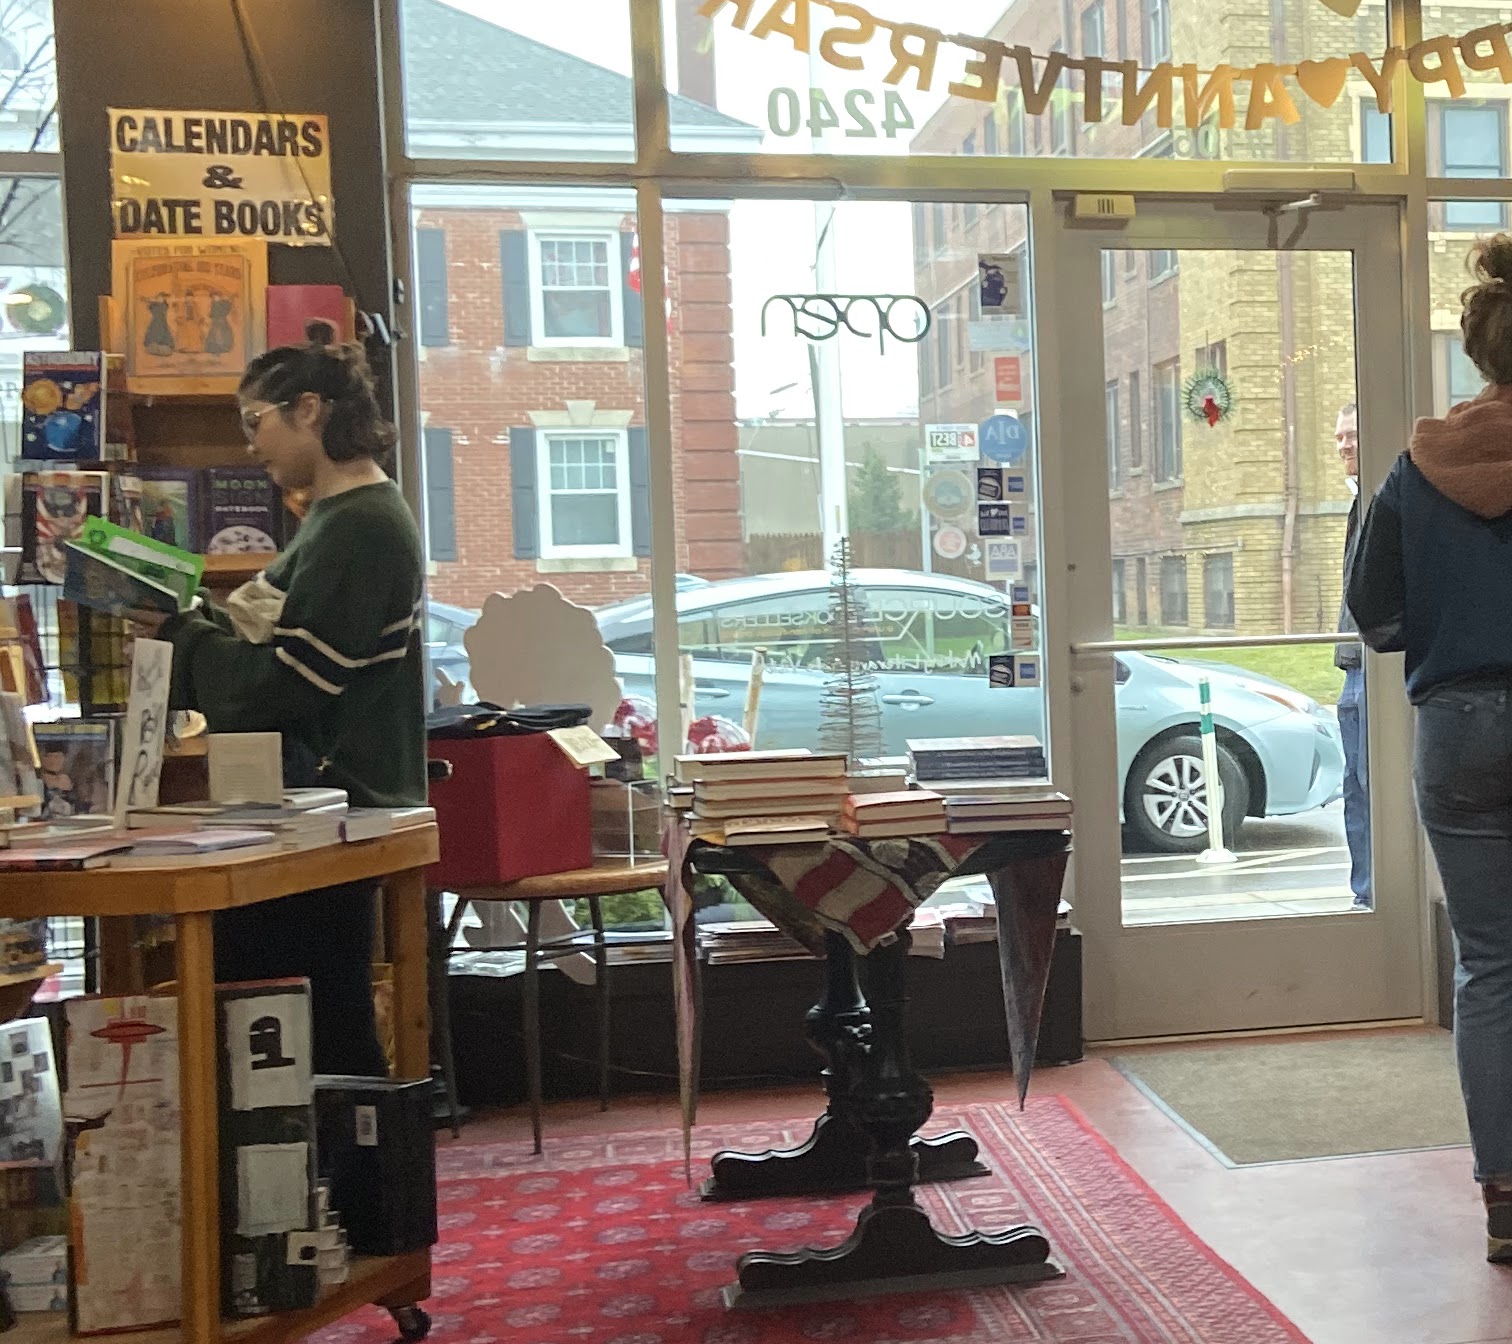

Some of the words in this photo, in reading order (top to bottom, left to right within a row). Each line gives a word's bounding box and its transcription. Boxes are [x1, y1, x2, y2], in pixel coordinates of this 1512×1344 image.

[116, 115, 323, 157] CALENDARS
[203, 165, 245, 189] &
[119, 197, 203, 235] DATE
[214, 199, 327, 236] BOOKS
